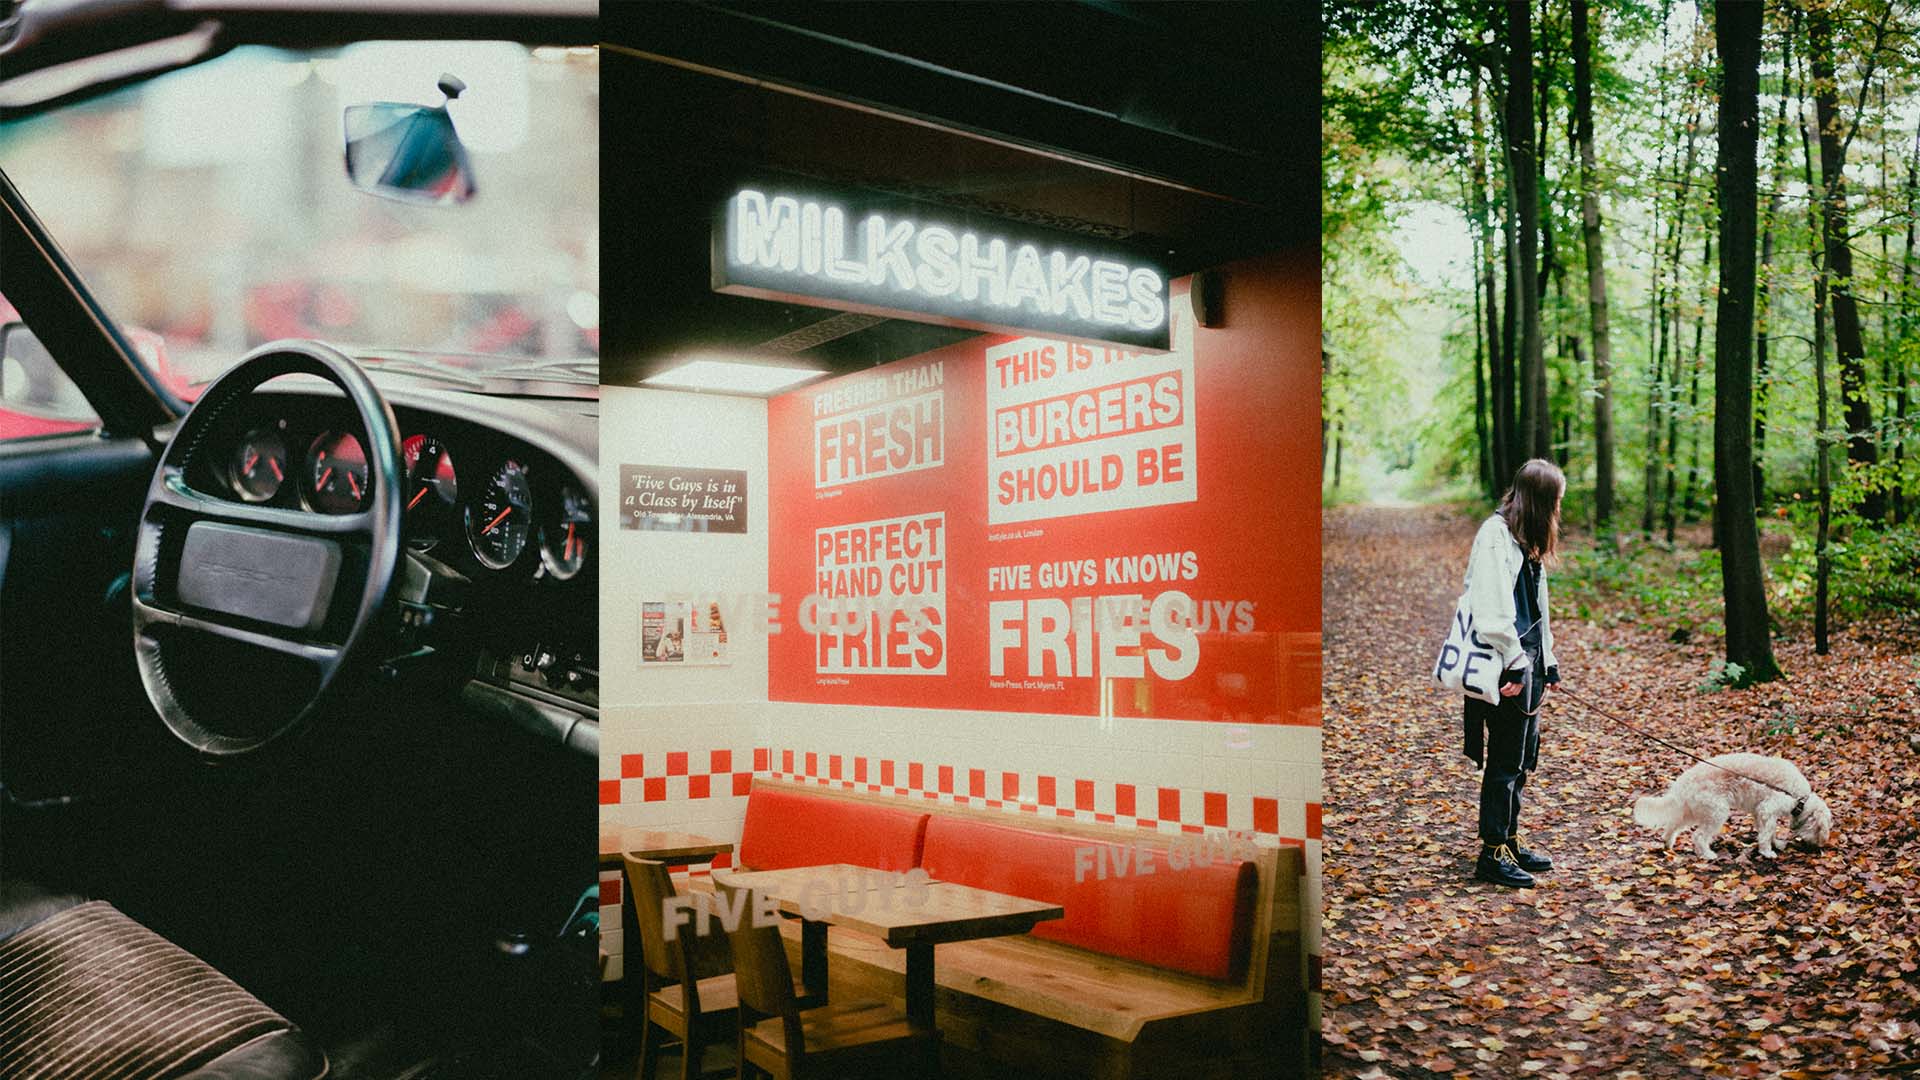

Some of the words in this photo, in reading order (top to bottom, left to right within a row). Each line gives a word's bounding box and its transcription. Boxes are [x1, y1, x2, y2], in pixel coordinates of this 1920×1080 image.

[737, 190, 1164, 330] MILKSHAKES
[815, 377, 888, 416] FRESHER
[894, 361, 943, 396] THAN
[996, 346, 1057, 389] THIS
[1067, 343, 1093, 373] IS
[820, 399, 941, 482] FRESH
[998, 376, 1180, 452] BURGERS
[625, 494, 635, 505] a
[639, 487, 678, 503] Class
[682, 490, 698, 513] by
[703, 495, 743, 513] Itself"
[632, 474, 665, 491] "Five
[669, 477, 702, 496] Guys
[707, 479, 719, 493] is
[723, 480, 736, 494] in
[998, 454, 1124, 505] SHOULD
[1137, 443, 1183, 487] BE
[818, 518, 942, 567] PERFECT
[818, 566, 882, 599] HAND
[890, 560, 943, 596] CUT
[989, 565, 1032, 591] FIVE
[1038, 559, 1098, 589] GUYS
[1105, 551, 1199, 584] KNOWS
[820, 607, 943, 669] FRIES
[989, 590, 1200, 680] FRIES
[1163, 599, 1255, 633] GUYS
[1437, 644, 1492, 694] PE
[1075, 840, 1155, 884] FIVE
[1168, 829, 1260, 871] GUYS
[662, 885, 781, 942] FIVE
[800, 868, 930, 922] GUYS
